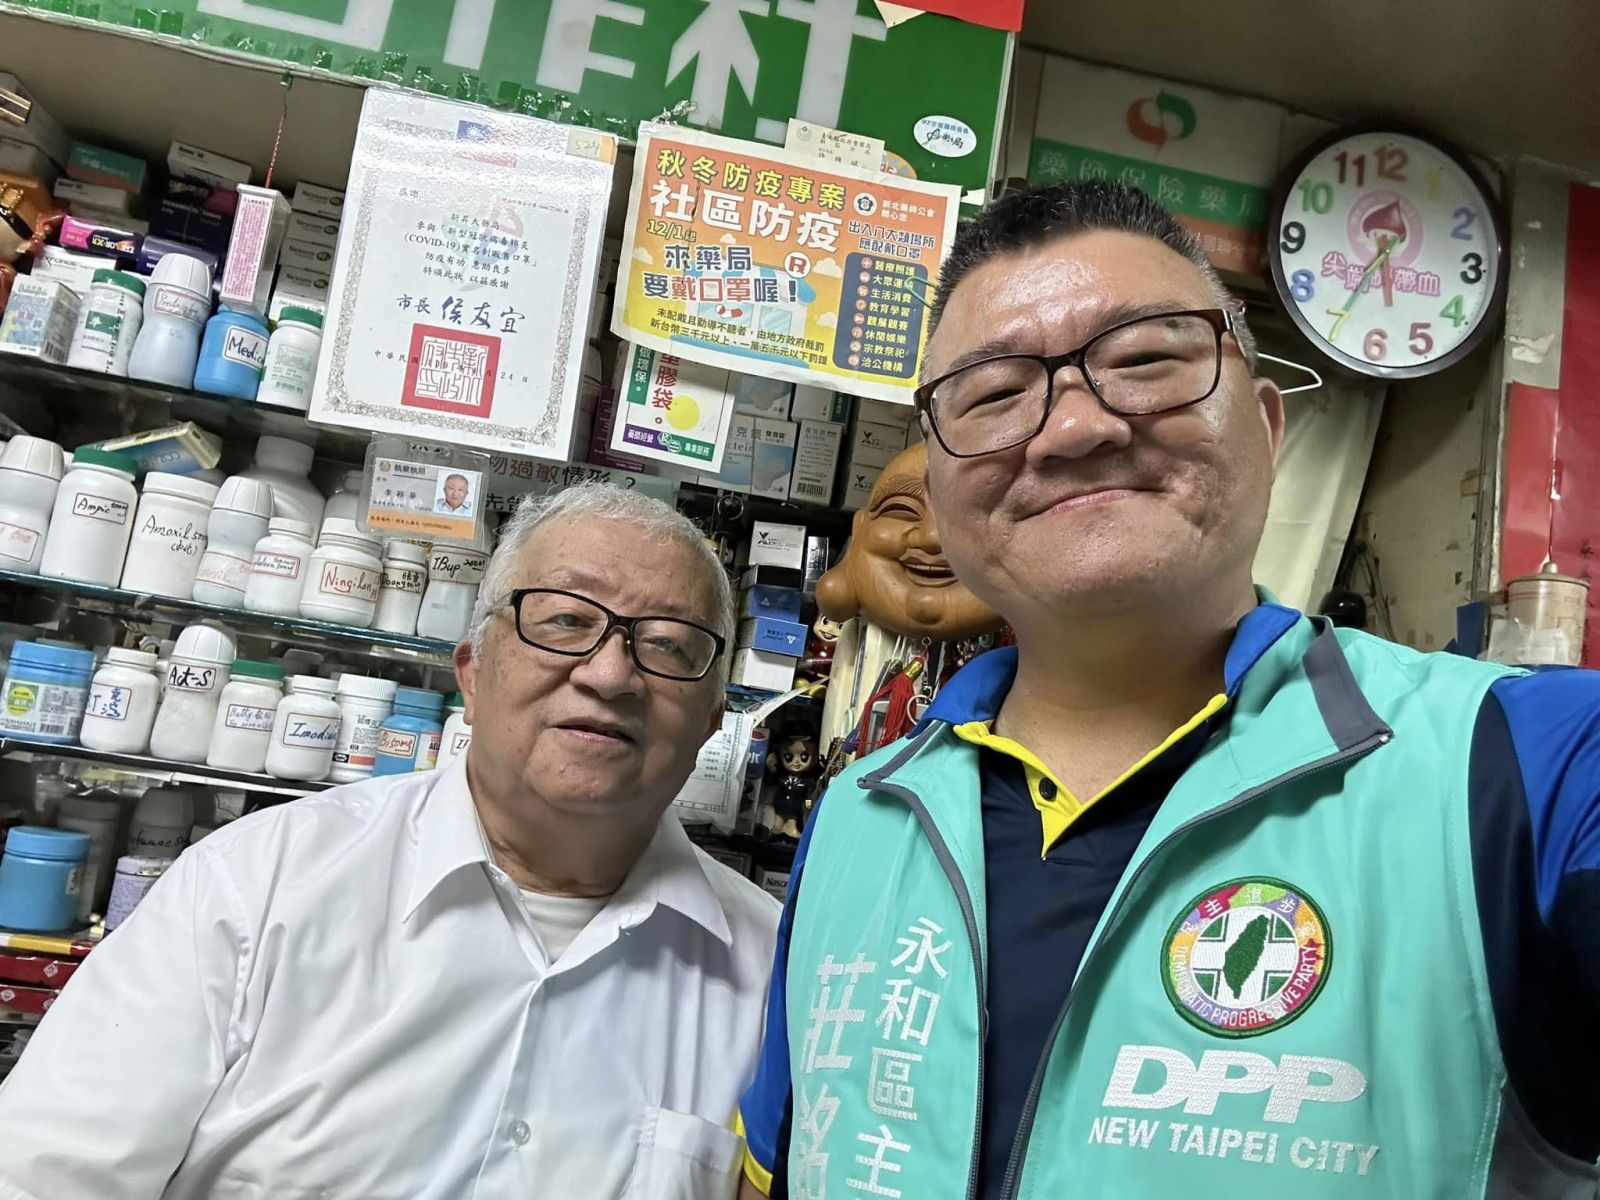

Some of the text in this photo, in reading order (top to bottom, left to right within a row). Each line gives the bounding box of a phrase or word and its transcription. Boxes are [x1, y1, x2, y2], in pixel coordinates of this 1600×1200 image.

[656, 149, 848, 212] 秋冬防疫專案
[1334, 151, 1367, 188] 11
[1373, 144, 1409, 183] 12
[1297, 178, 1335, 215] 10
[1425, 167, 1443, 200] 1
[646, 219, 698, 243] 12/1起
[649, 178, 844, 254] 社區防疫
[1450, 206, 1478, 242] 2
[847, 219, 936, 249] 出入八大類場所
[858, 237, 922, 260] 應配戴口罩
[1280, 221, 1307, 255] 9
[663, 245, 752, 272] 來藥局
[874, 259, 917, 277] 醫療照護
[1459, 252, 1484, 285] 3
[870, 288, 913, 305] 生活消費
[1289, 268, 1316, 303] 8
[395, 293, 526, 334] 市長 侯友宜
[868, 301, 911, 318] 教育學習
[1325, 307, 1350, 342] 7
[1439, 294, 1467, 329] 4
[862, 343, 905, 360] 宗教祭祀
[1362, 328, 1389, 362] 6
[1407, 322, 1434, 356] 5
[860, 356, 904, 373] 洽公機構
[1294, 944, 1319, 991] PARTY
[1101, 1044, 1368, 1124] DPP
[1088, 1116, 1380, 1176] NEW TAIPEI CITY
